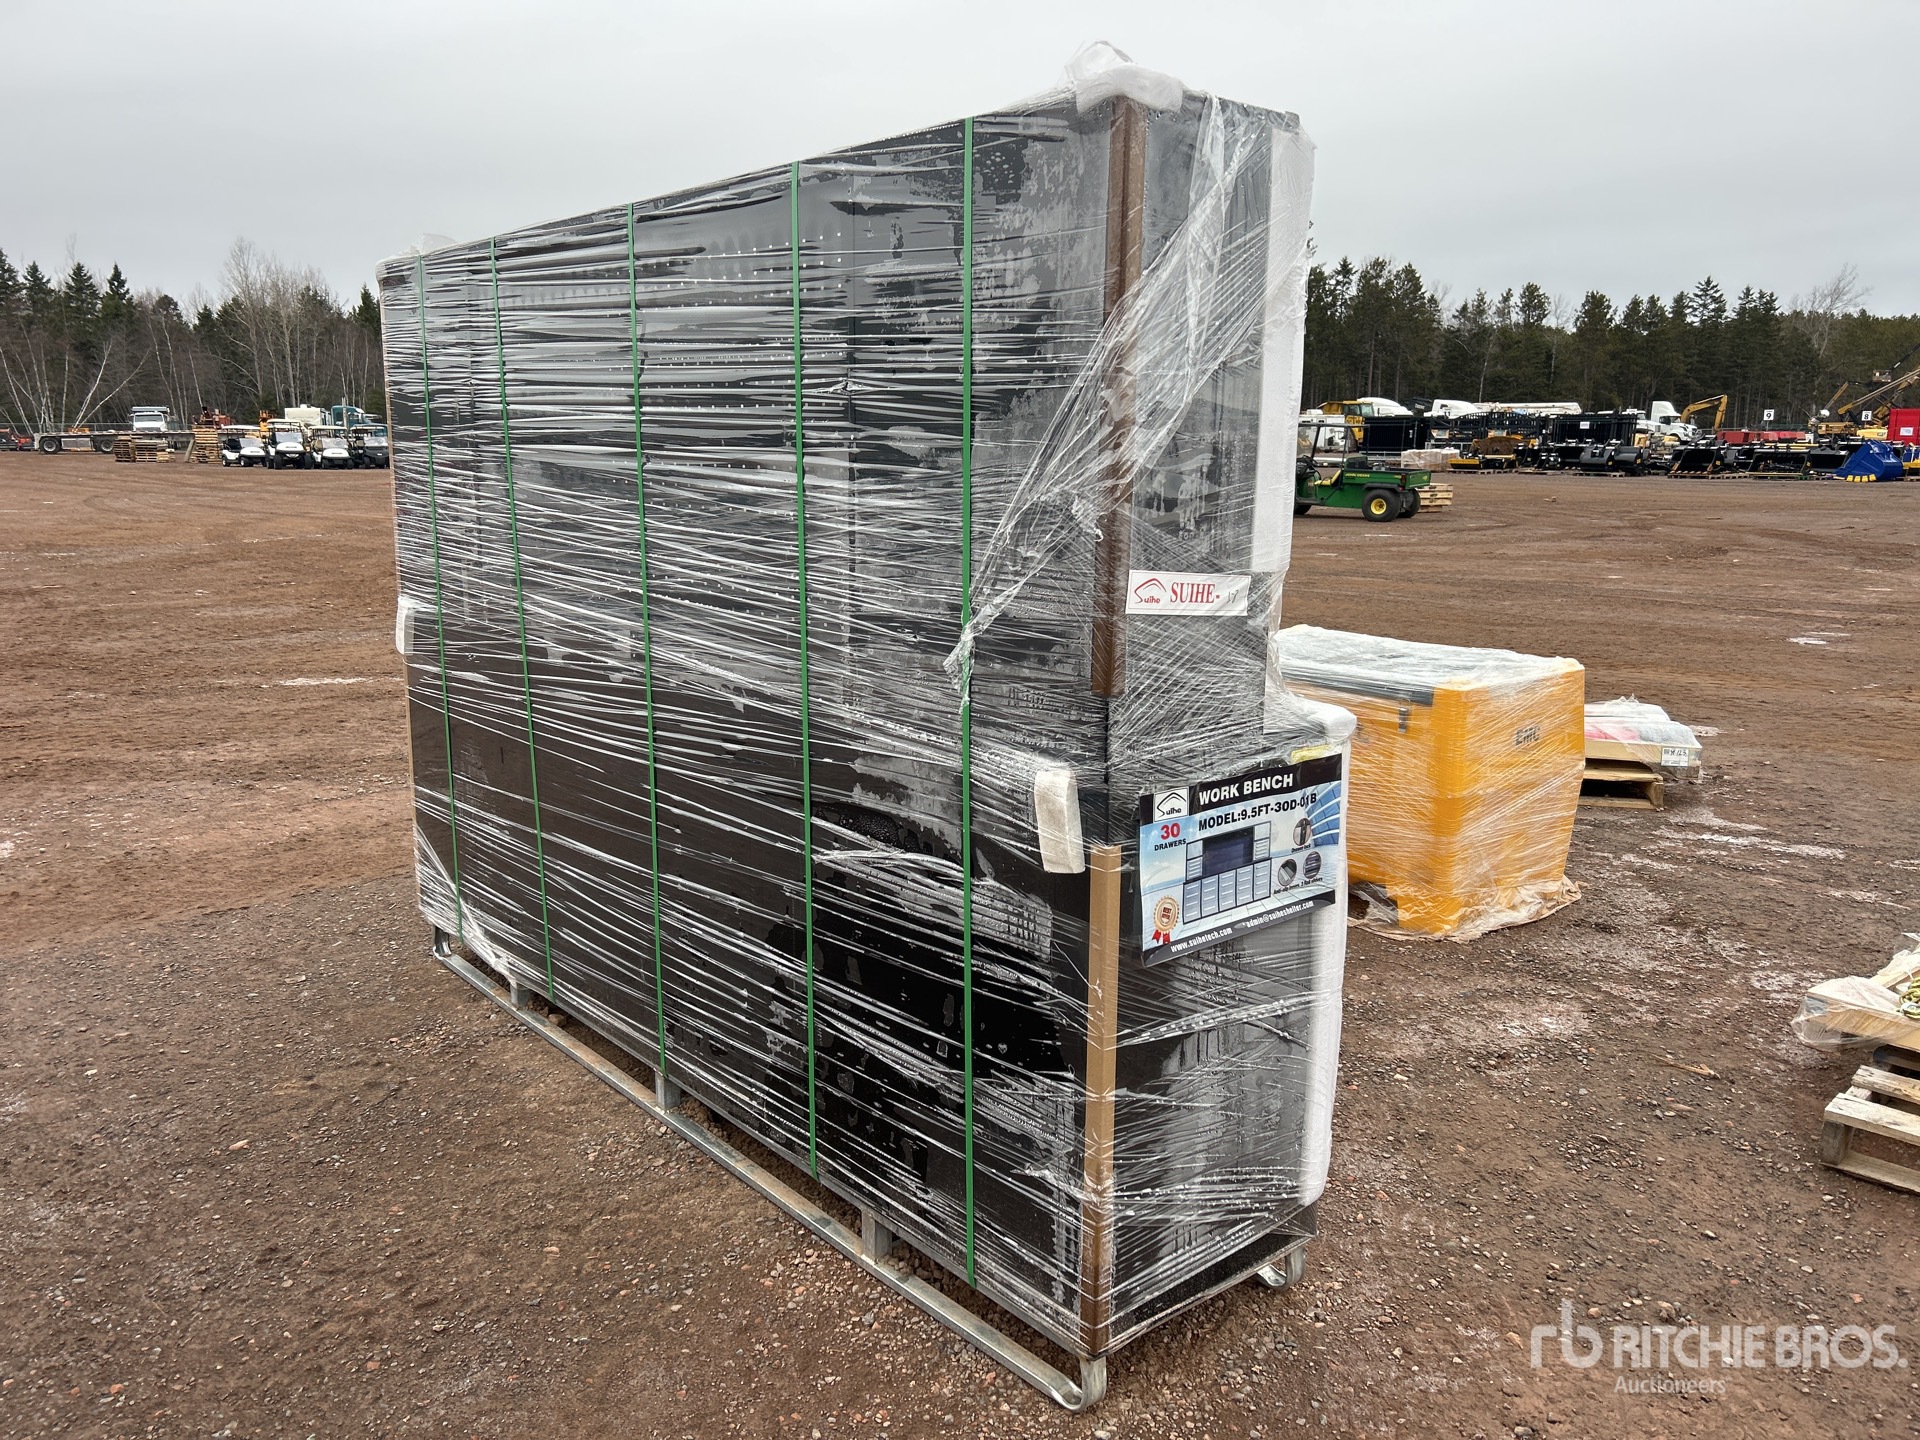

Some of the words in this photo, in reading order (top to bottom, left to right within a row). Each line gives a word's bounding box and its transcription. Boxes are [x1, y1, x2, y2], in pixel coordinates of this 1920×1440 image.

[1199, 783, 1240, 805] WORK
[1243, 773, 1294, 795] BENCH
[1161, 822, 1181, 840] 30
[1154, 838, 1187, 851] DRAWERS
[1170, 927, 1233, 953] www.suihetech.com
